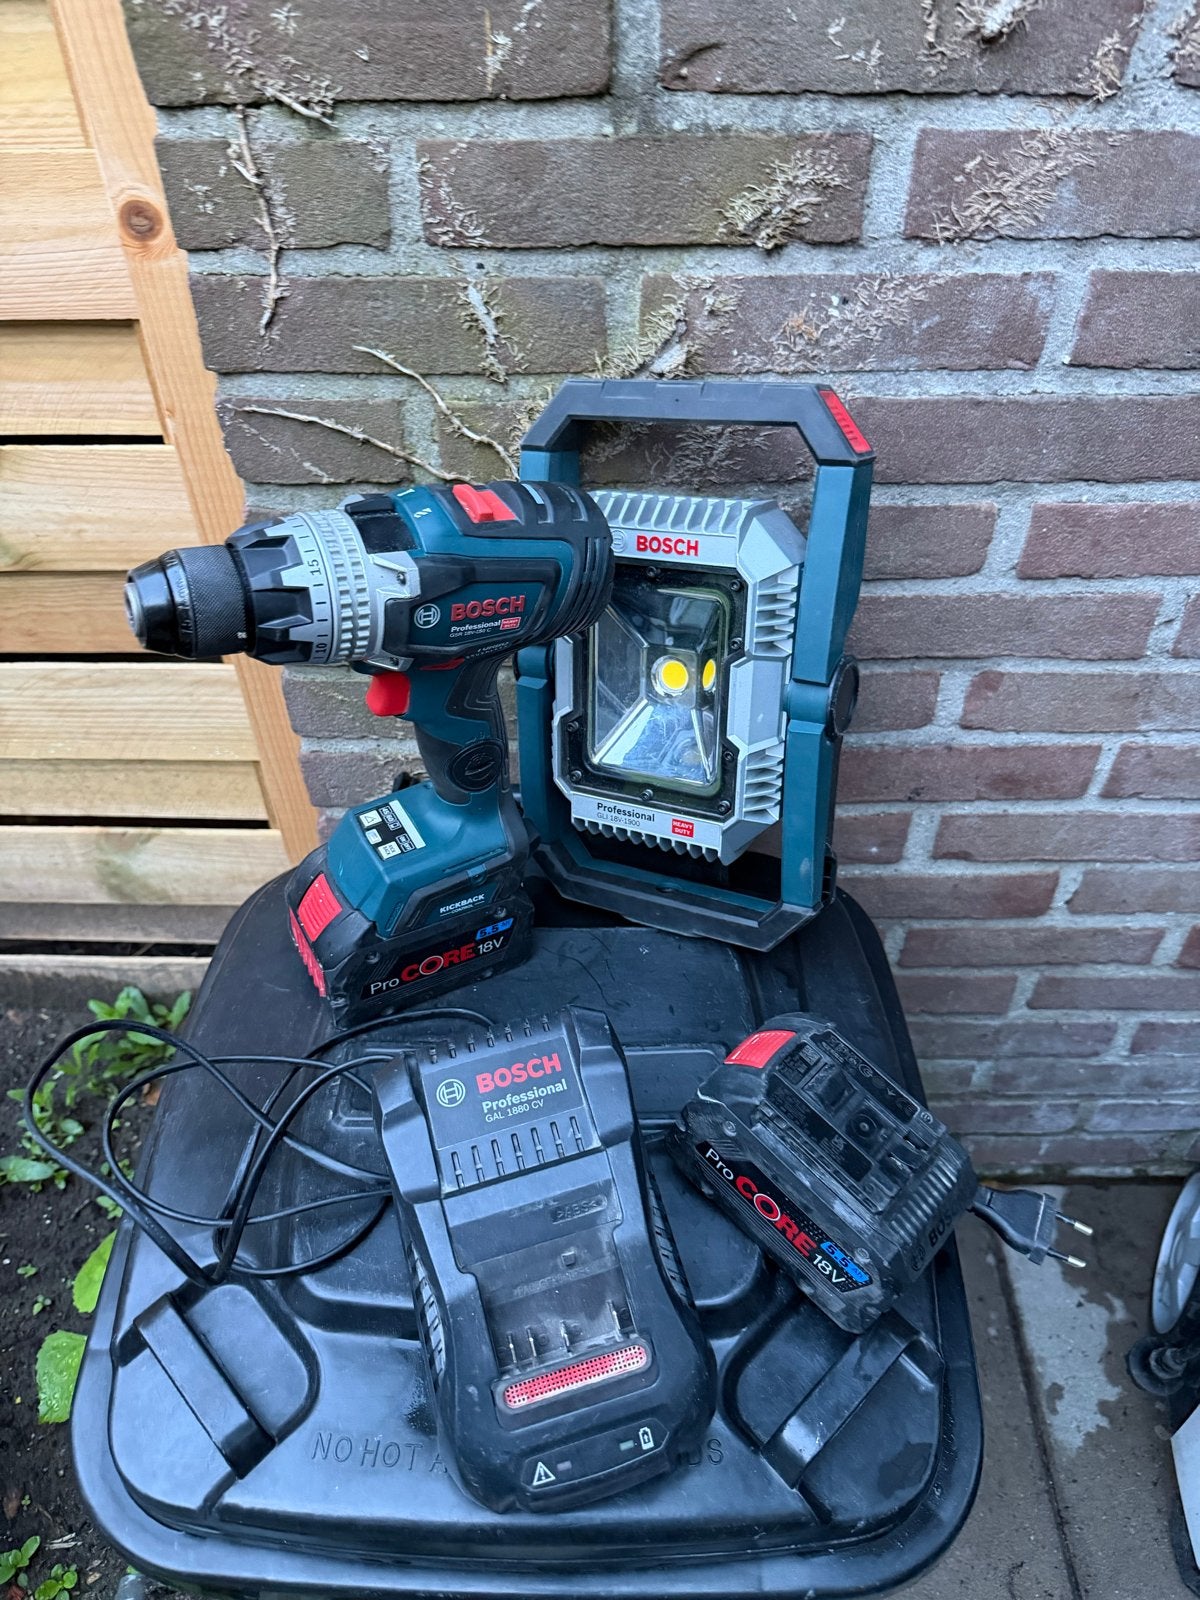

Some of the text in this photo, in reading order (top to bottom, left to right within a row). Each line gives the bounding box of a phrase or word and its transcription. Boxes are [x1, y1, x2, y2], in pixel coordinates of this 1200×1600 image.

[636, 534, 699, 557] BOSCH
[307, 558, 322, 576] 15
[450, 595, 526, 622] BOSCH
[450, 620, 501, 633] Professional
[596, 802, 655, 822] Professional
[596, 812, 609, 821] GLI
[672, 818, 694, 830] HEAVY
[673, 826, 691, 836] DUTY
[439, 893, 486, 914] KICKBACK
[479, 924, 500, 937] 5.5
[475, 1052, 562, 1094] BOSCH
[481, 1078, 568, 1114] Professional
[485, 1098, 544, 1123] GAL 1880 CV
[826, 1244, 851, 1268] 5.5
[311, 1432, 353, 1463] NO
[360, 1438, 424, 1471] HOT
